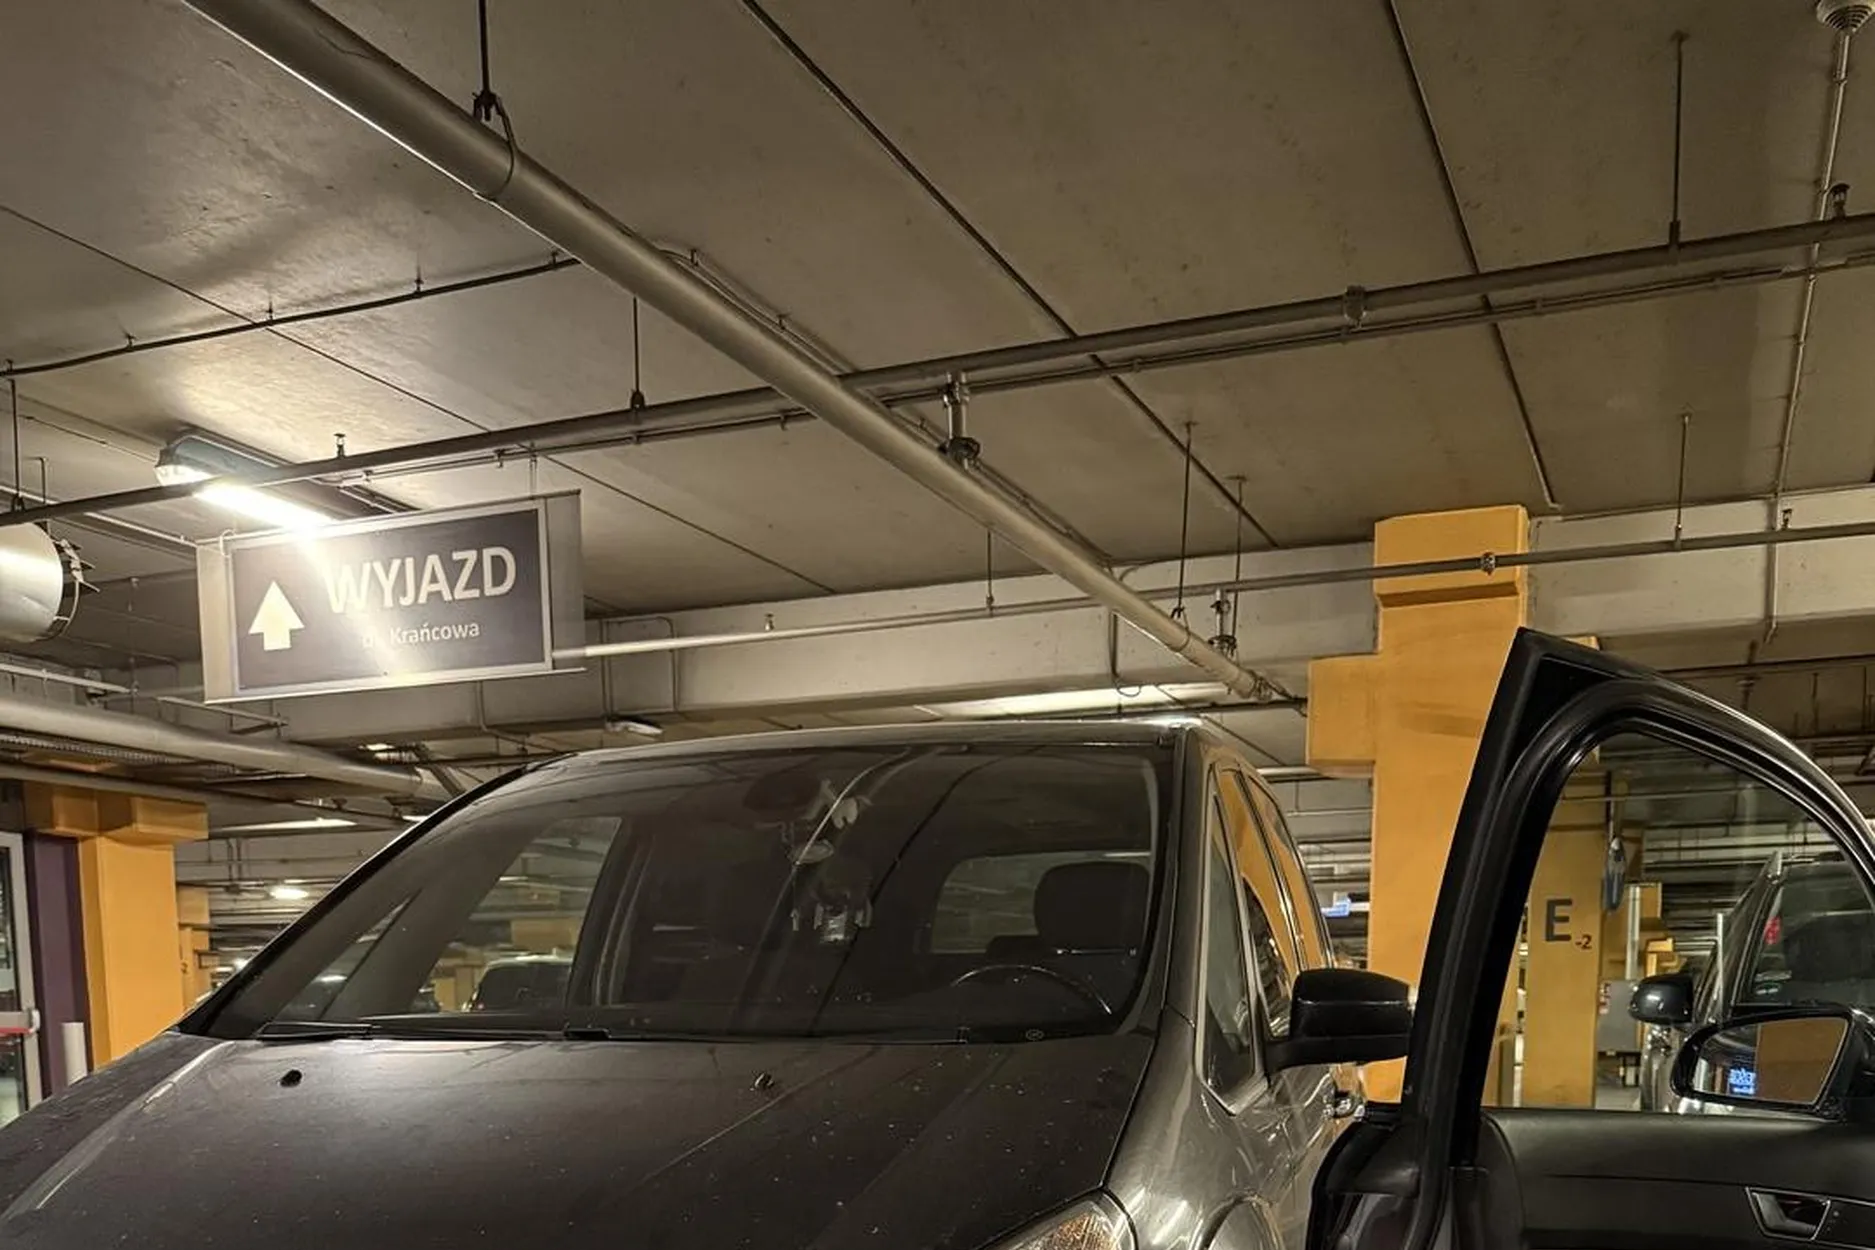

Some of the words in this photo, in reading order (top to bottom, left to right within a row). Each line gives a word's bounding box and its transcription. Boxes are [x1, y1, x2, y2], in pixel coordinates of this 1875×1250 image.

[324, 547, 515, 613] WYJAZD
[390, 622, 480, 644] Krańcowa
[1545, 899, 1573, 942] E
[1575, 935, 1593, 949] -2
